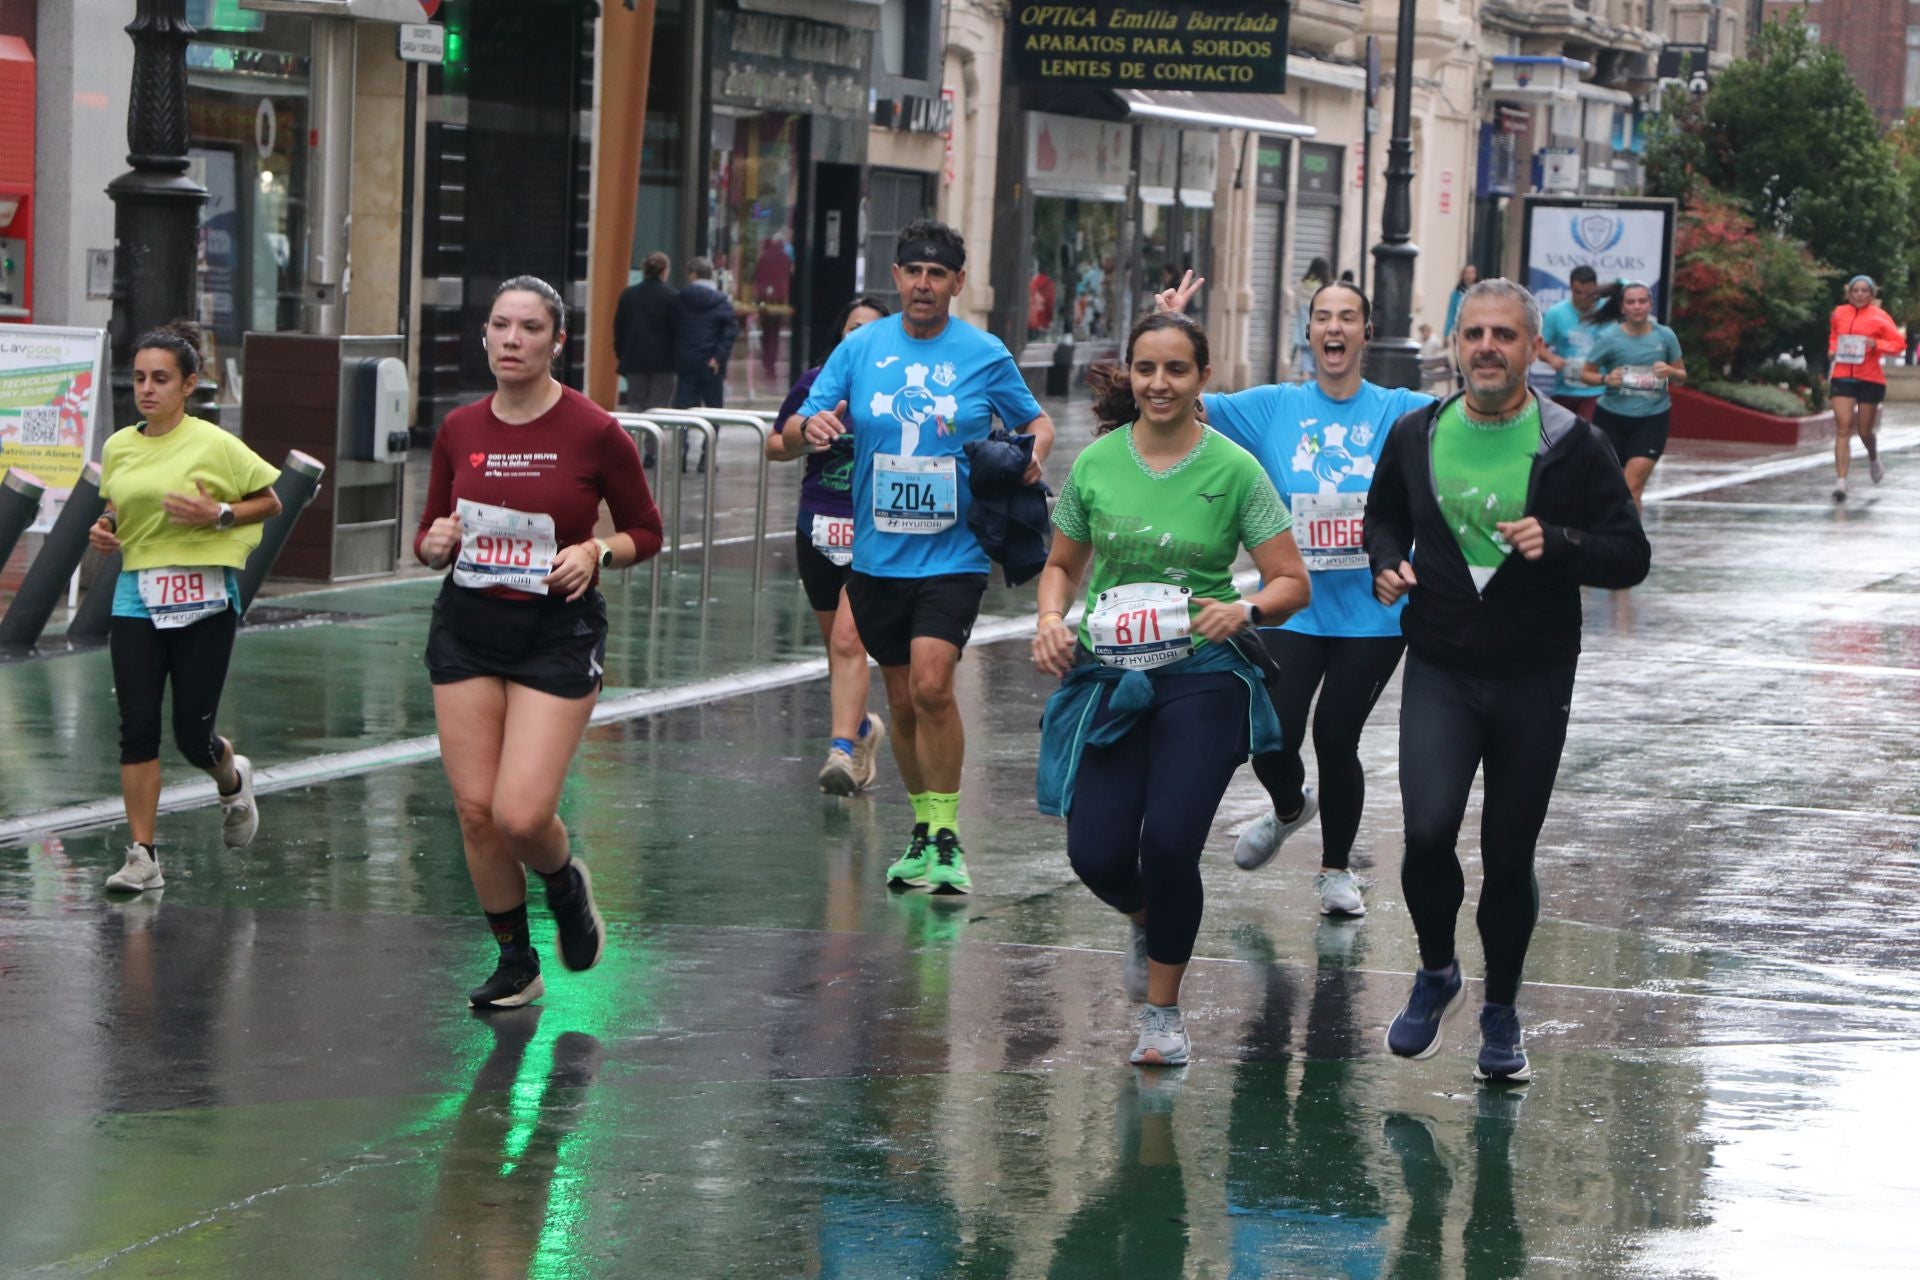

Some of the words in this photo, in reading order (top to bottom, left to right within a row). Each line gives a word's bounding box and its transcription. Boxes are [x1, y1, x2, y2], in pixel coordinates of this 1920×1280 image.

[1020, 6, 1097, 27] OPTICA
[1108, 8, 1178, 31] Emilia
[1186, 11, 1279, 33] Barriada
[1025, 34, 1126, 54] APARATOS
[1132, 37, 1184, 55] PARA
[1191, 39, 1272, 58] SORDOS
[1041, 59, 1112, 78] LENTES
[1119, 62, 1145, 79] DE
[1153, 63, 1254, 82] CONTACTO
[891, 482, 936, 511] 204
[902, 519, 942, 528] HYUNDAI
[1308, 519, 1363, 547] 1066
[476, 535, 533, 566] 903
[156, 573, 204, 604] 789
[1115, 608, 1161, 644] 871
[1129, 651, 1178, 665] HYUNDAI
